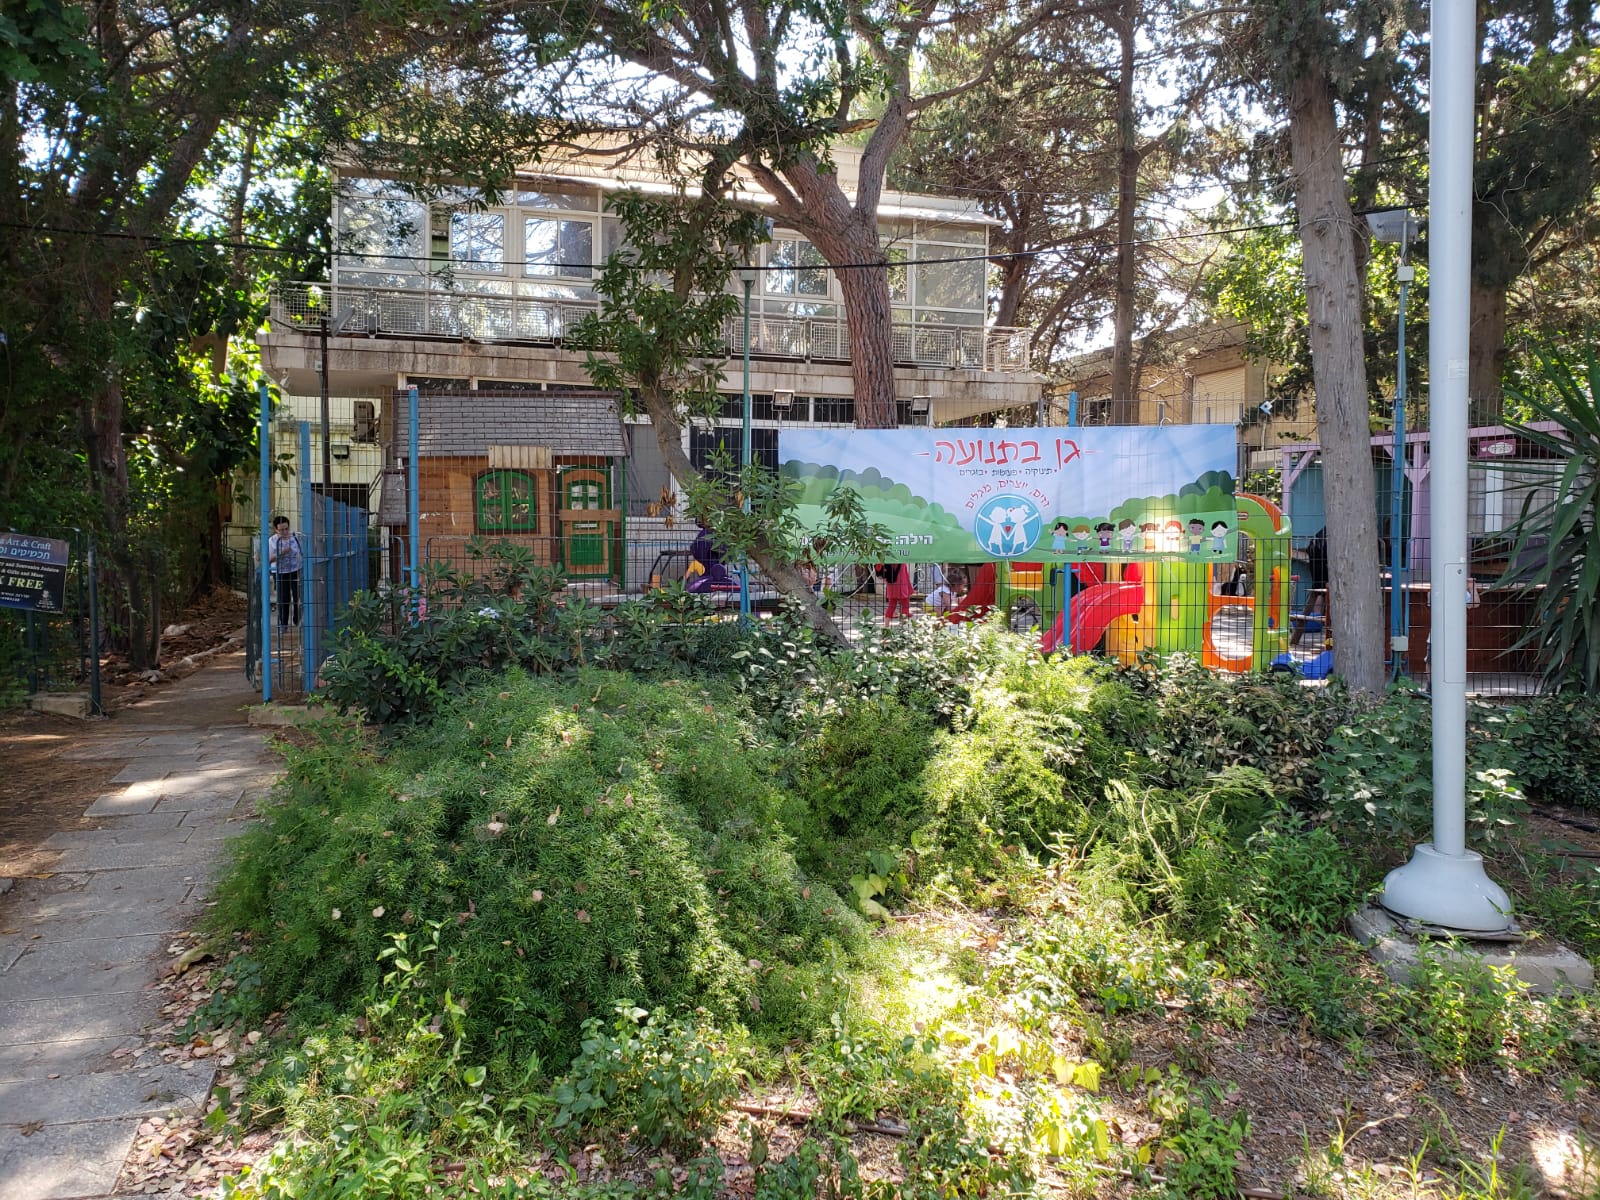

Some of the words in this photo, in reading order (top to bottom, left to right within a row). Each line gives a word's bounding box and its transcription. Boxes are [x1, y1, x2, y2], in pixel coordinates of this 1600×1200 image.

[935, 439, 1042, 466] בתנועה
[1055, 438, 1081, 470] גן
[959, 468, 985, 476] בוגרים
[965, 484, 992, 509] מגלים
[6, 538, 20, 547] Art
[20, 539, 29, 548] &
[31, 540, 52, 551] Craft
[895, 533, 934, 545] הילה:
[10, 547, 51, 560] תכשיטים
[8, 576, 44, 590] FREE
